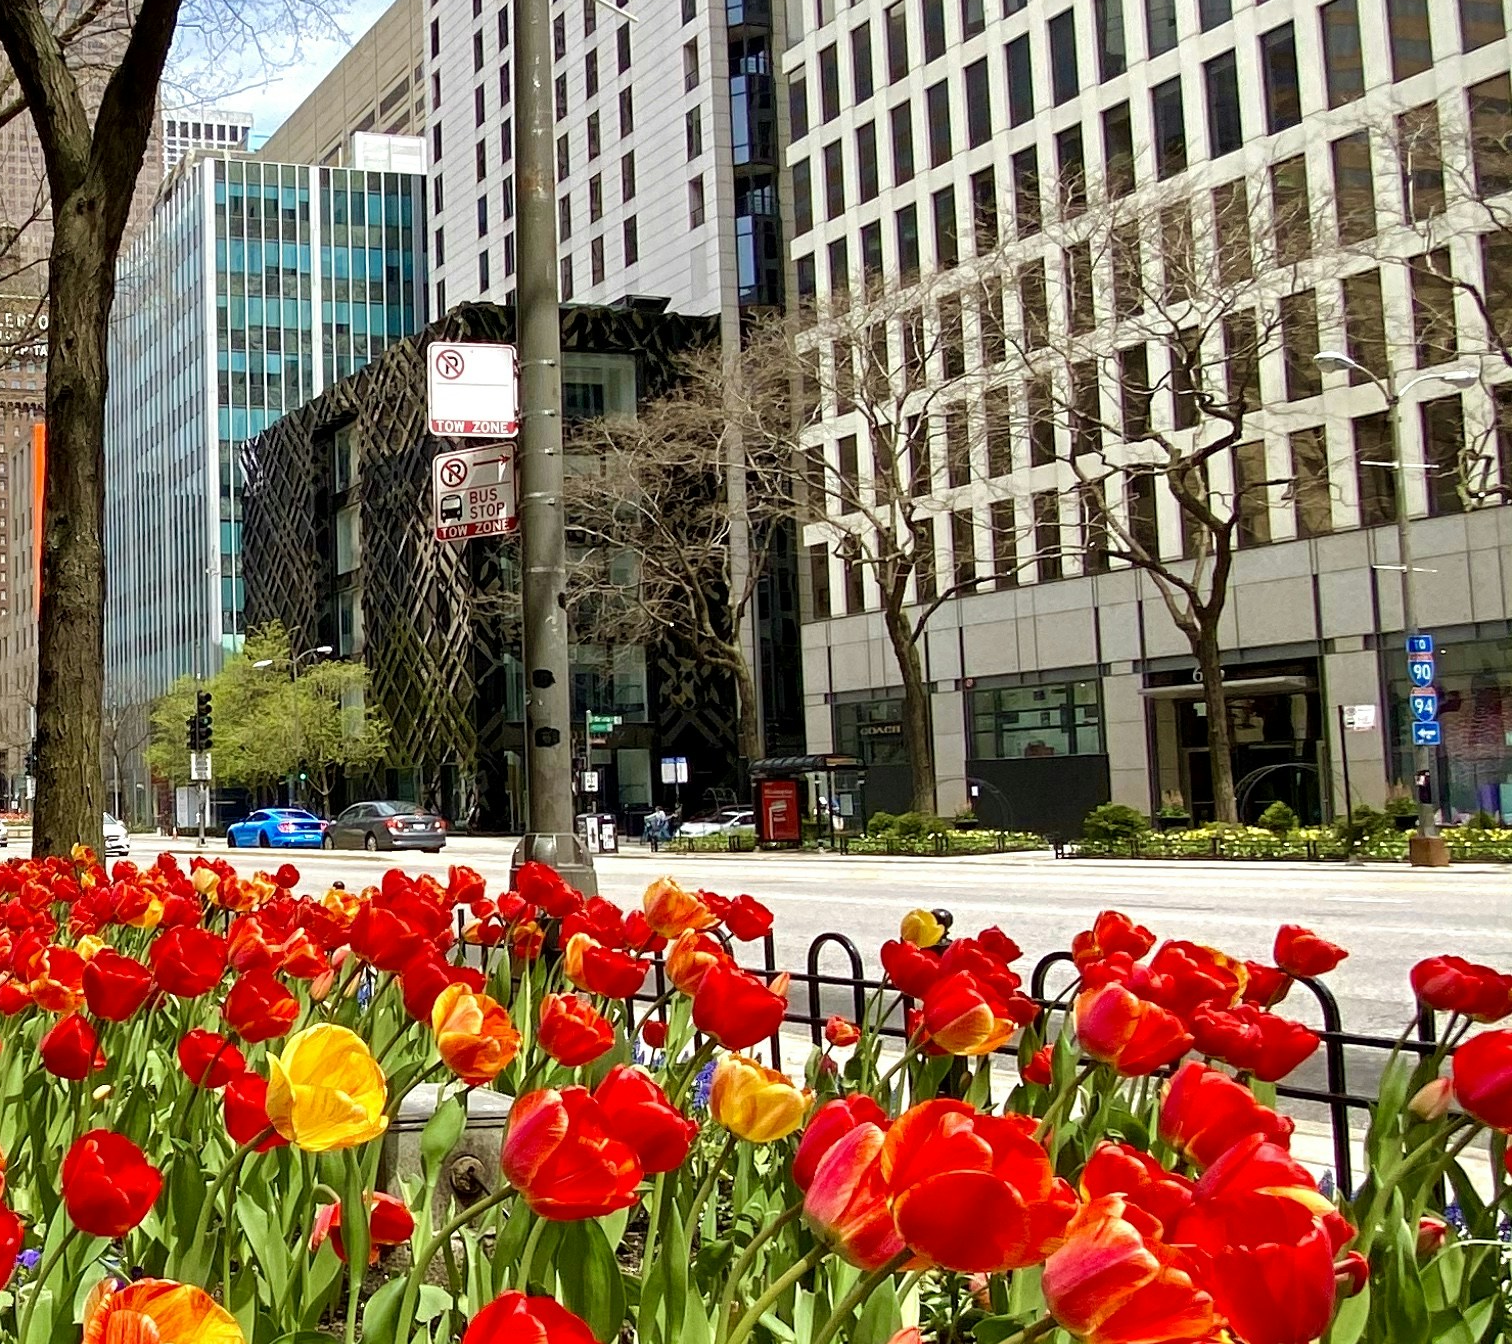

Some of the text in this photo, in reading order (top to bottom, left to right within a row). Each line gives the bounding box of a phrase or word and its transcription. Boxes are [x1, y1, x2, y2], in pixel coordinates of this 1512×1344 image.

[436, 420, 509, 434] TOW ZONE
[469, 488, 498, 504] BUS
[470, 502, 505, 519] STOP
[440, 518, 510, 538] TOW ZONE
[1413, 664, 1431, 680] 90
[1414, 698, 1433, 714] 94
[860, 725, 901, 735] COACH
